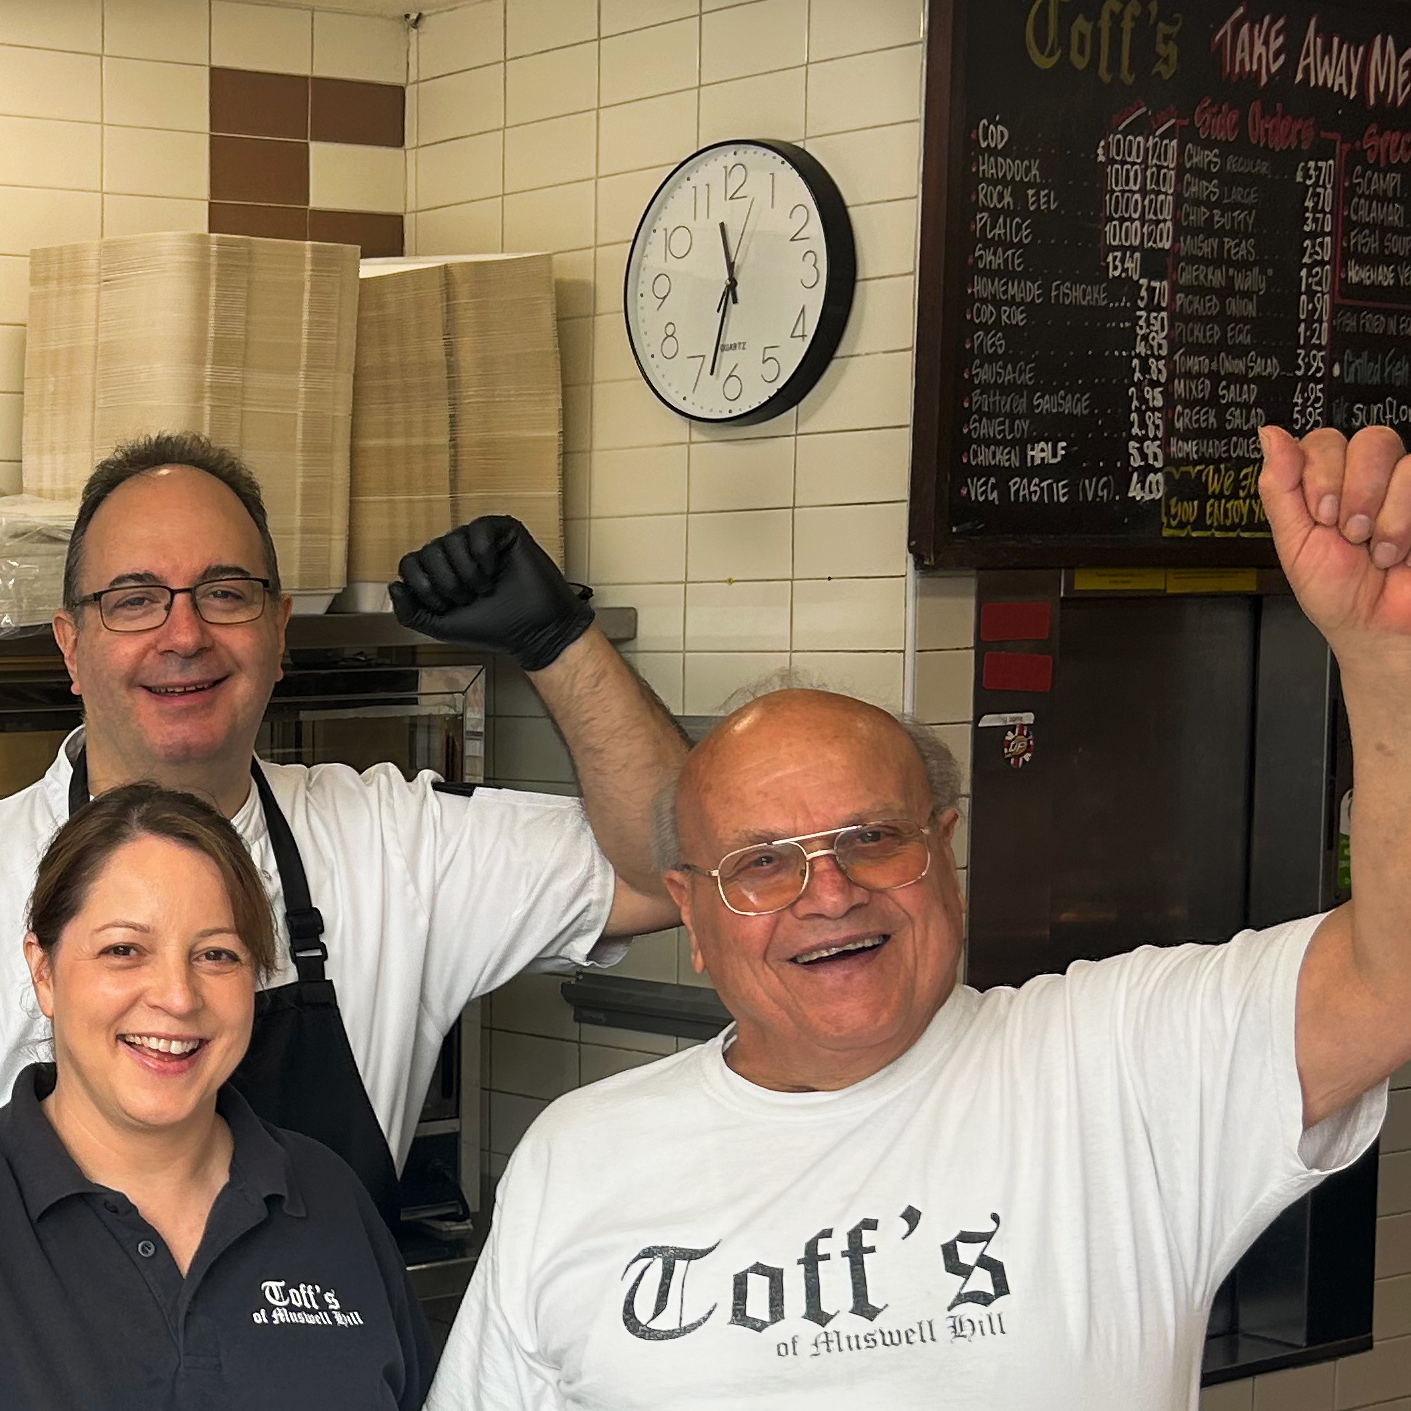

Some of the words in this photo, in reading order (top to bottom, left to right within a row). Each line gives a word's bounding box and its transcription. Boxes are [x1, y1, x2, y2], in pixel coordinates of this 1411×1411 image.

[1211, 4, 1288, 89] TAKE
[1294, 14, 1365, 101] AWAY
[977, 118, 1009, 150] COD
[1194, 96, 1240, 142] Side
[1247, 100, 1317, 151] Orders
[978, 153, 1040, 183] HADDOCK
[1184, 143, 1221, 173] CHIPS
[723, 163, 748, 201] 12
[770, 172, 775, 208] 1
[1182, 173, 1220, 202] CHIPS
[1223, 187, 1259, 204] LARGE
[1352, 165, 1401, 197] SCAMPI
[692, 183, 710, 221] 11
[977, 183, 1014, 210] ROCK
[1027, 189, 1058, 211] EEL
[789, 203, 810, 242] 2
[975, 211, 1033, 244] PLAICE
[1180, 203, 1209, 229] CHIP
[1213, 209, 1256, 234] BUTTY
[1350, 197, 1405, 229] CALAMARI
[663, 225, 693, 263] 10
[1179, 234, 1218, 261] MUSHY
[1223, 238, 1256, 262] PEAS
[1349, 227, 1379, 255] FISH
[801, 250, 820, 289] 3
[974, 243, 1024, 272] SKATE
[1106, 250, 1141, 281] 13.40
[1177, 261, 1226, 289] GHERKIN
[652, 273, 672, 311] 9
[973, 275, 1043, 303] HOMEMADE
[1051, 280, 1108, 307] FISHCAKE
[1175, 293, 1220, 316] PICKLED
[1225, 294, 1257, 318] ONION
[790, 304, 808, 342] 4
[973, 302, 996, 325] COD
[1001, 306, 1027, 326] ROE
[661, 322, 679, 359] 8
[973, 330, 1006, 353] PIES
[1175, 322, 1221, 345] PICKLED
[1226, 322, 1251, 345] EGG
[686, 354, 706, 394] 7
[761, 345, 781, 383] 5
[971, 359, 1035, 386] SAUSAGE
[722, 363, 743, 401] 6
[1174, 377, 1211, 400] MIXED
[1218, 380, 1257, 405] SALAD
[1033, 390, 1090, 417] SAUSAGE
[1174, 405, 1217, 431] GREEK
[1225, 407, 1265, 431] SALAD
[969, 414, 1030, 440] SAVELOY
[969, 443, 1020, 468] CHICKEN
[1026, 441, 1067, 467] HALF
[1170, 437, 1229, 461] HOMEMADE
[967, 477, 999, 505] VEG
[1009, 477, 1069, 503] PASTIE
[1202, 463, 1235, 496] We
[1206, 498, 1250, 526] ENJOY
[621, 1204, 1011, 1341] Toff's
[261, 1279, 341, 1310] Toff's
[252, 1308, 269, 1324] of
[270, 1306, 333, 1326] Muswell
[331, 1310, 364, 1328] Hill
[776, 1335, 799, 1358] of
[809, 1318, 940, 1358] Muswell
[944, 1312, 1007, 1344] Hill
